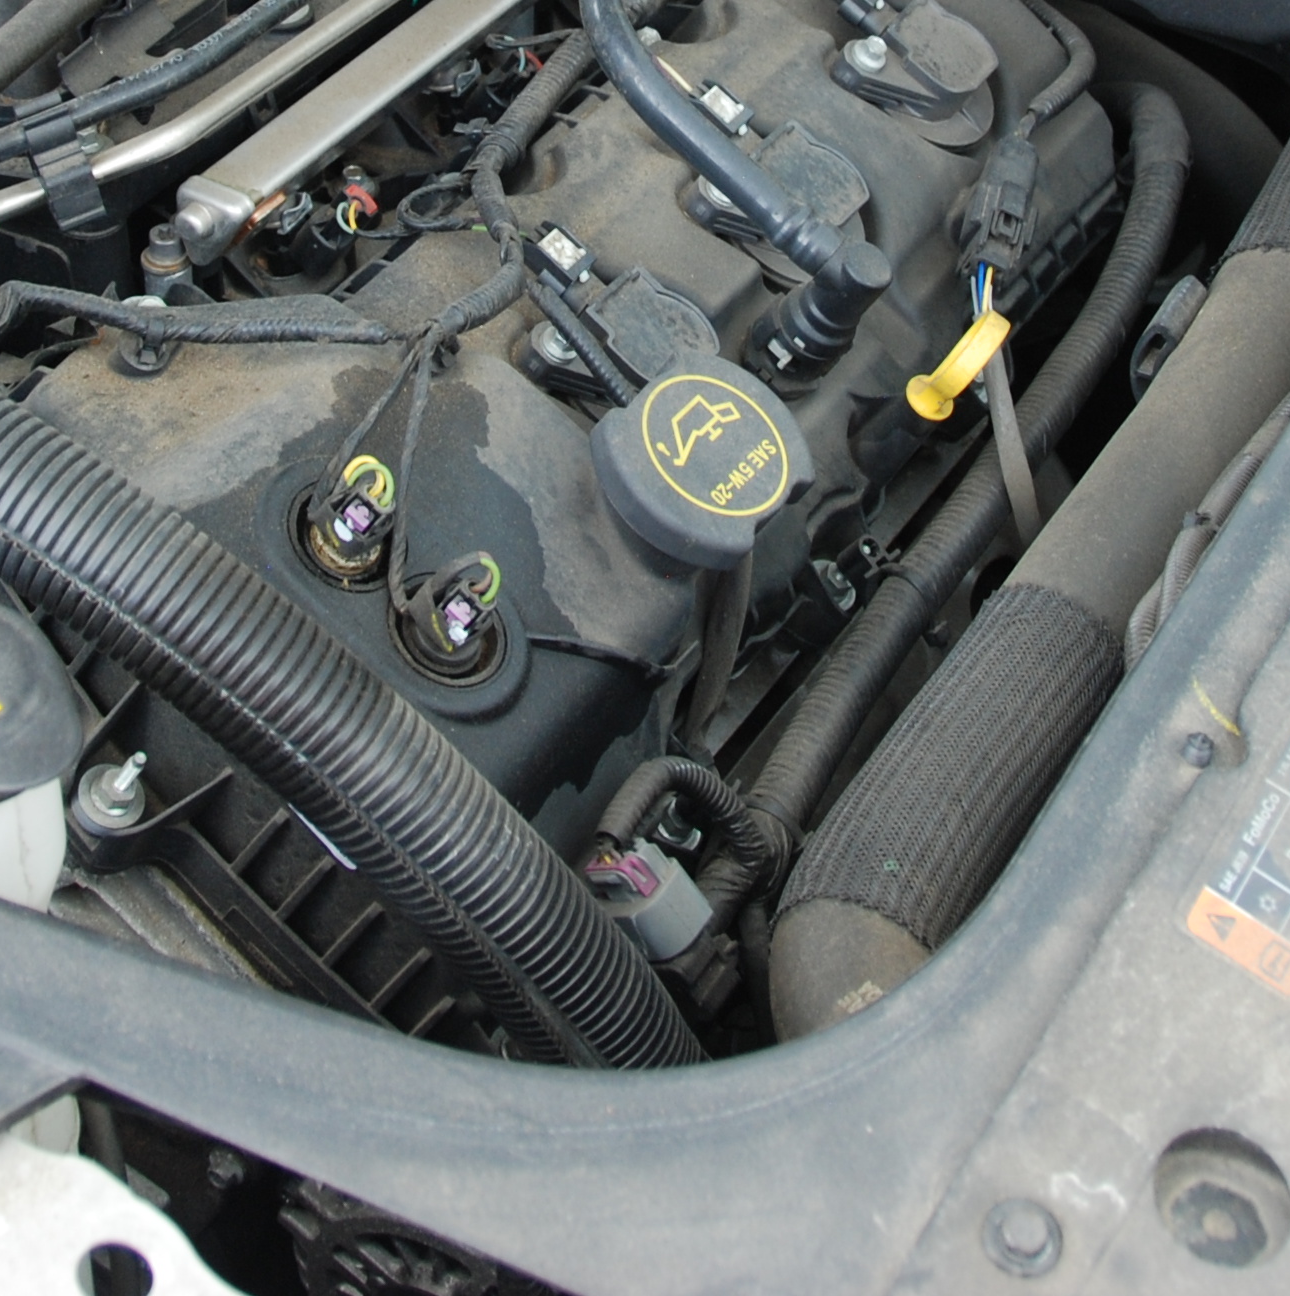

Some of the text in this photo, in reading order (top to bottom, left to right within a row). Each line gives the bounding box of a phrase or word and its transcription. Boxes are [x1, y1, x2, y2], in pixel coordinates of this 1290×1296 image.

[710, 438, 777, 506] SAE 5W-20
[1242, 790, 1281, 846] FoMoCo
